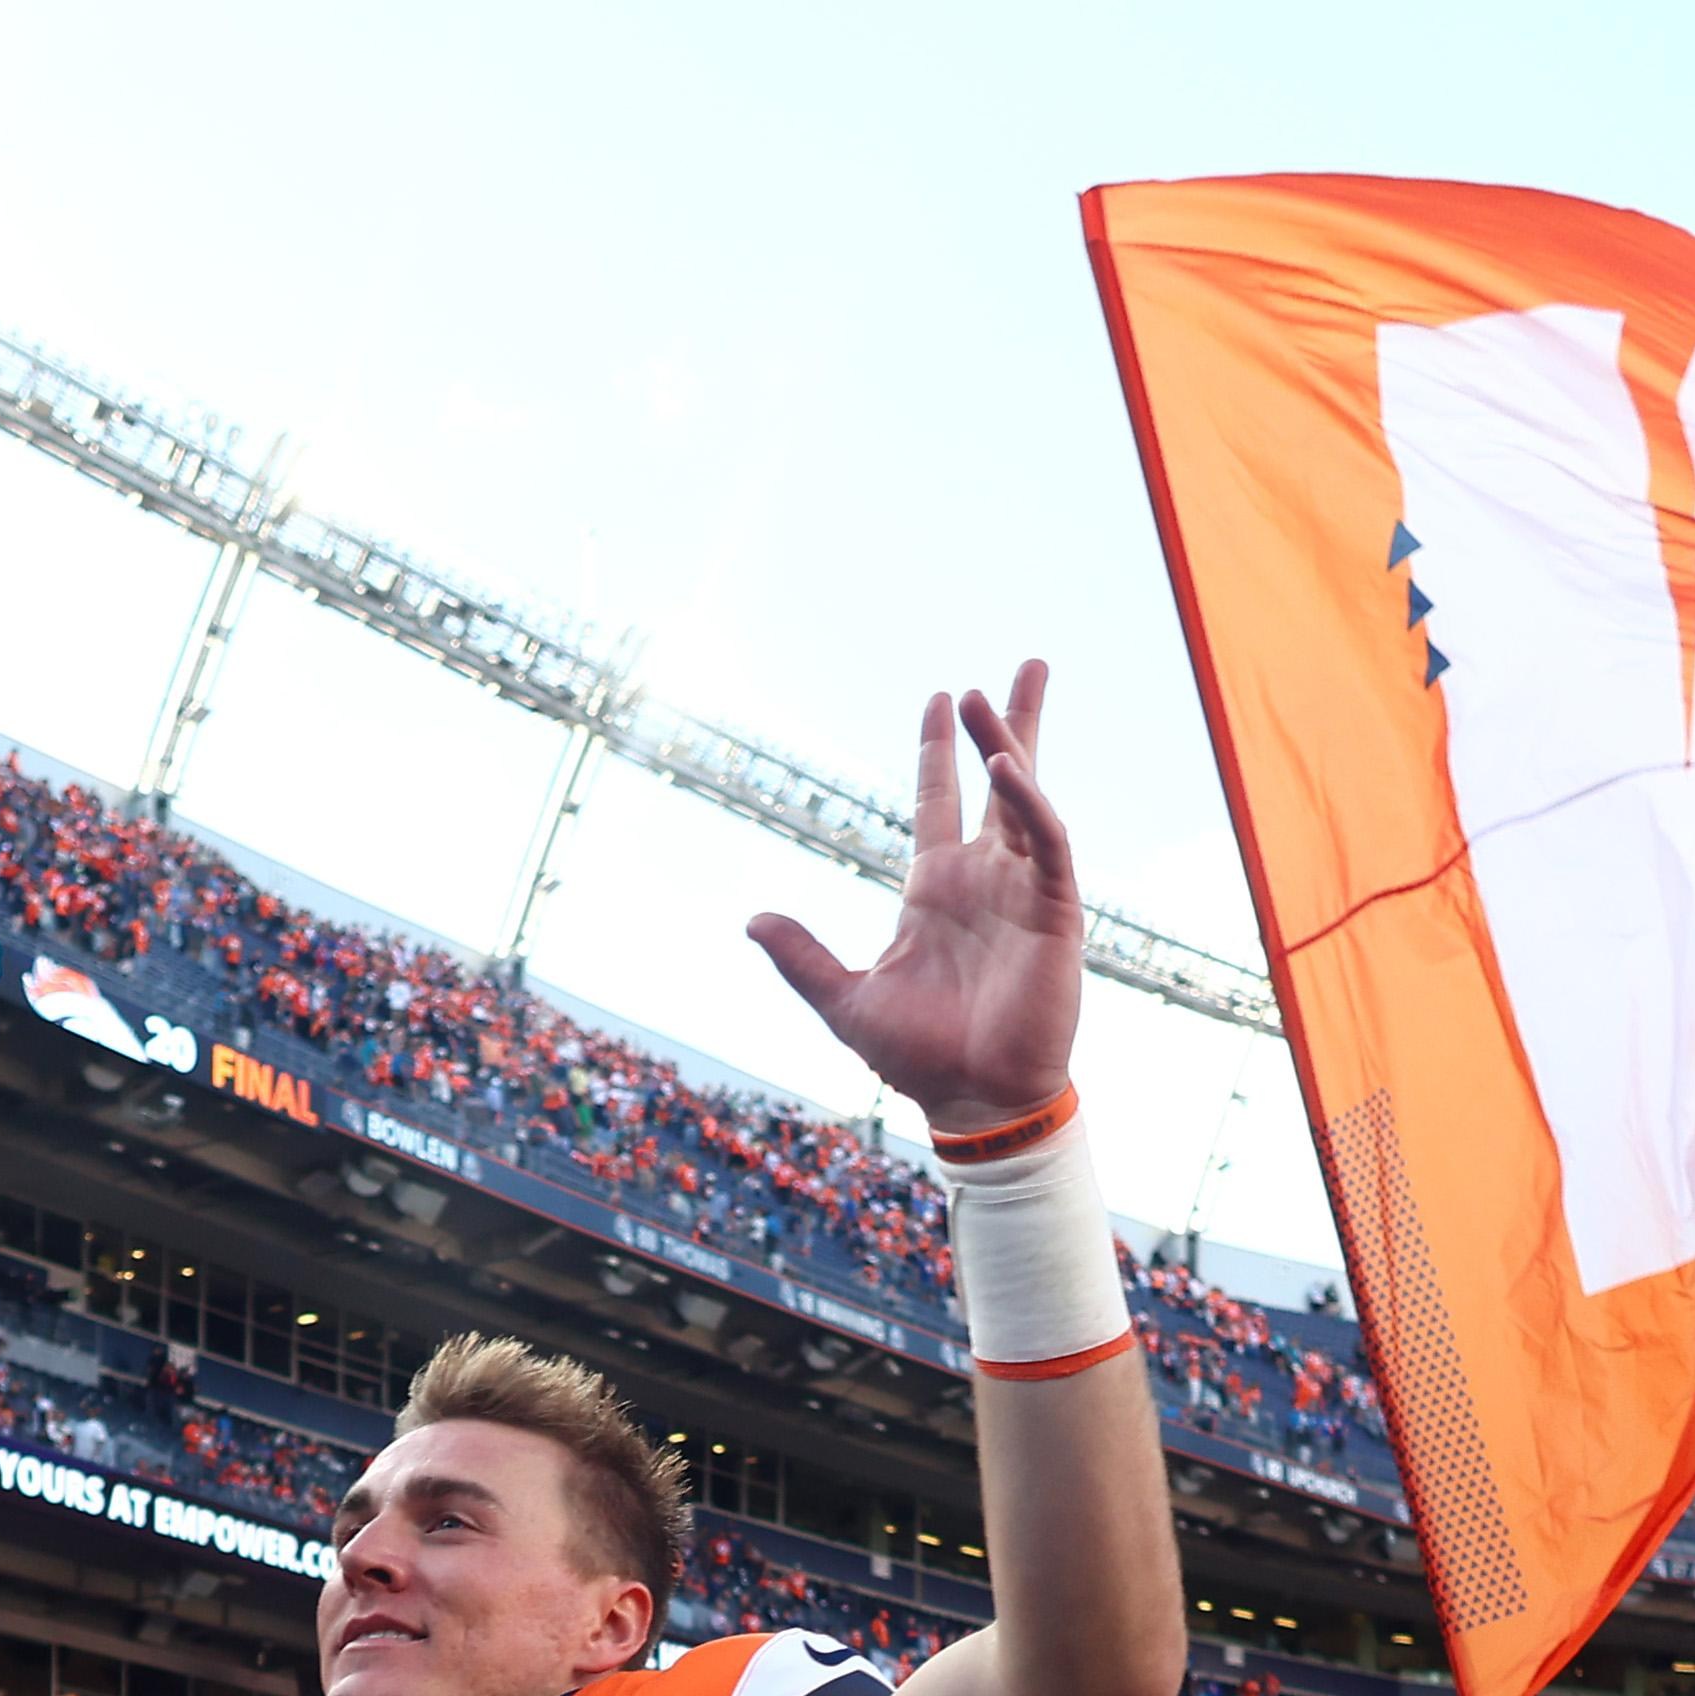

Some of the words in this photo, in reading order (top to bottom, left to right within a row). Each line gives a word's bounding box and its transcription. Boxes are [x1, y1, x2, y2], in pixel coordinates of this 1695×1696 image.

[143, 1015, 197, 1074] 20
[211, 1044, 319, 1128] FINAL
[366, 1107, 459, 1174] BOWLEN
[108, 1482, 150, 1529] AT
[153, 1495, 338, 1582] EMPOWER.CO
